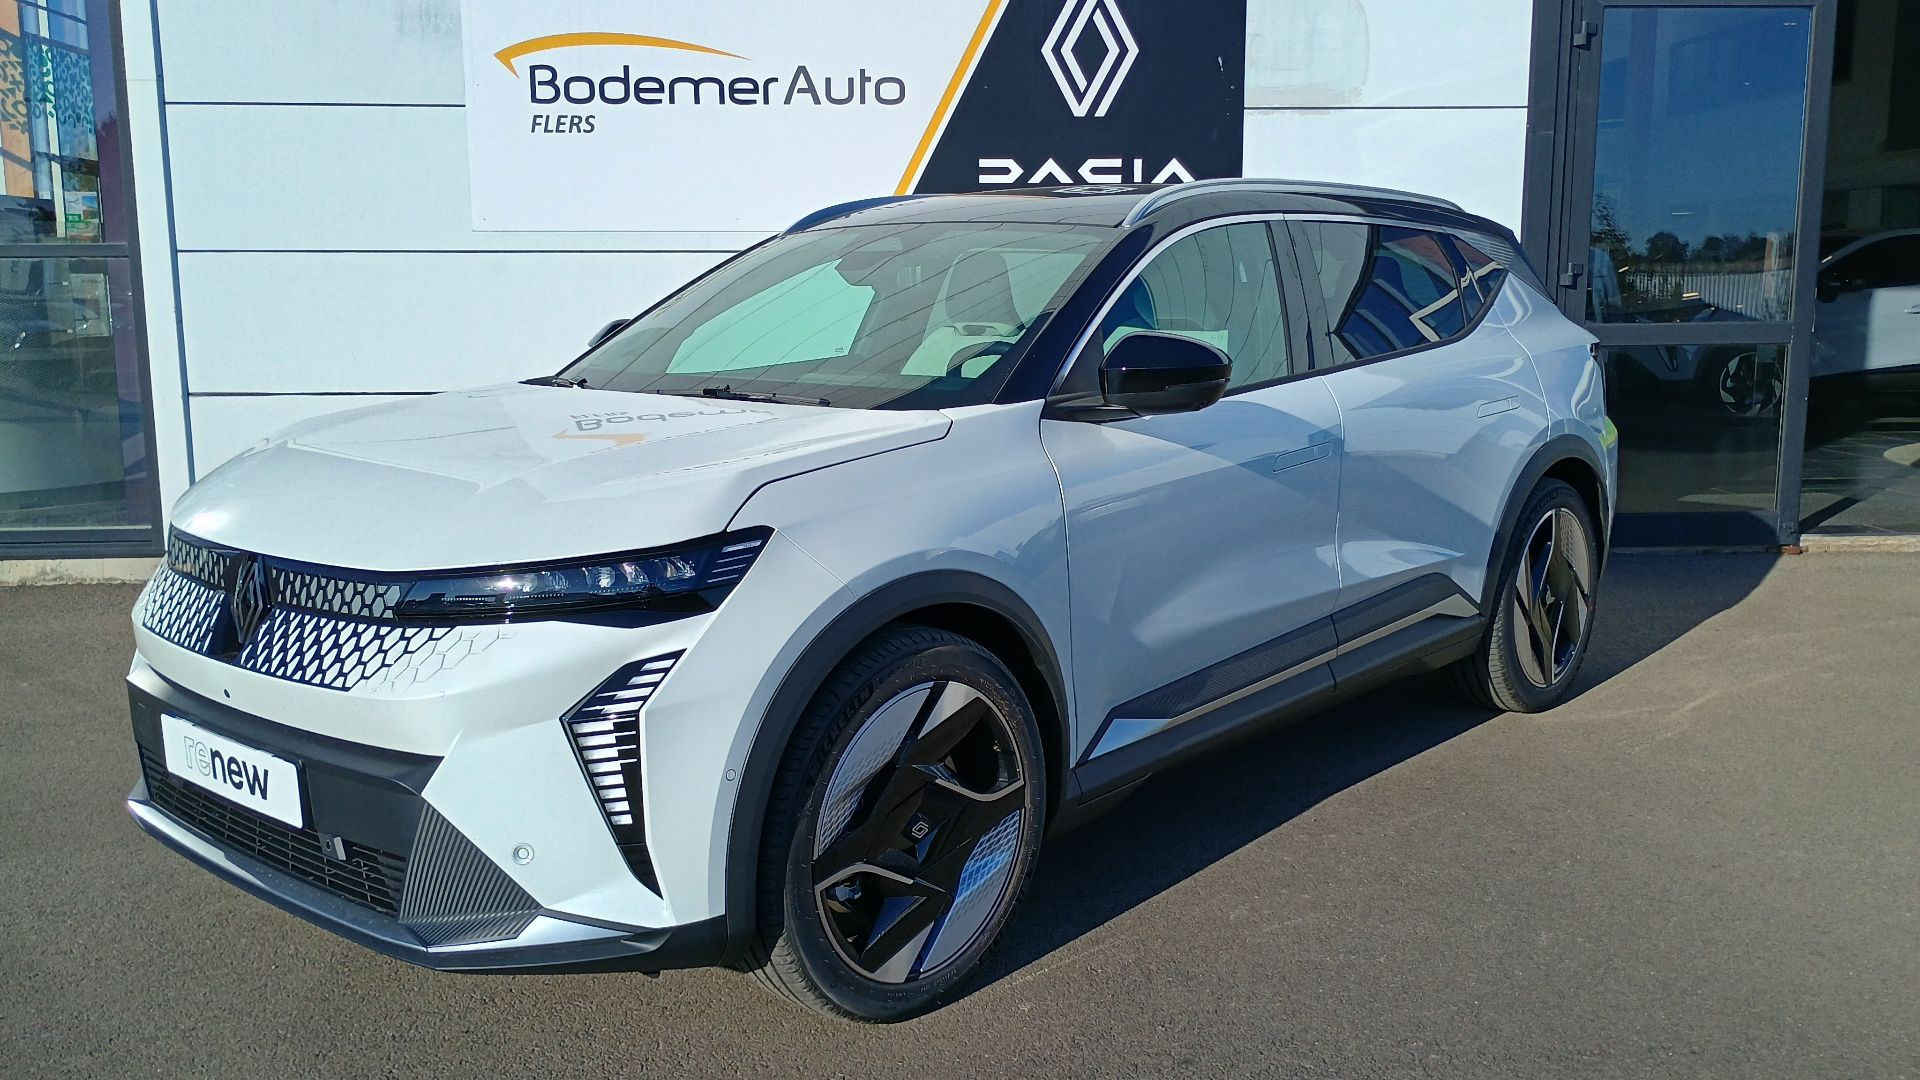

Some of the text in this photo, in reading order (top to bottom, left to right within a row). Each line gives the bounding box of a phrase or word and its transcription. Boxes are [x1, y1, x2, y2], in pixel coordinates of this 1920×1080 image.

[531, 114, 596, 133] FLERS
[978, 157, 1196, 184] DACIA
[183, 735, 269, 801] renew
